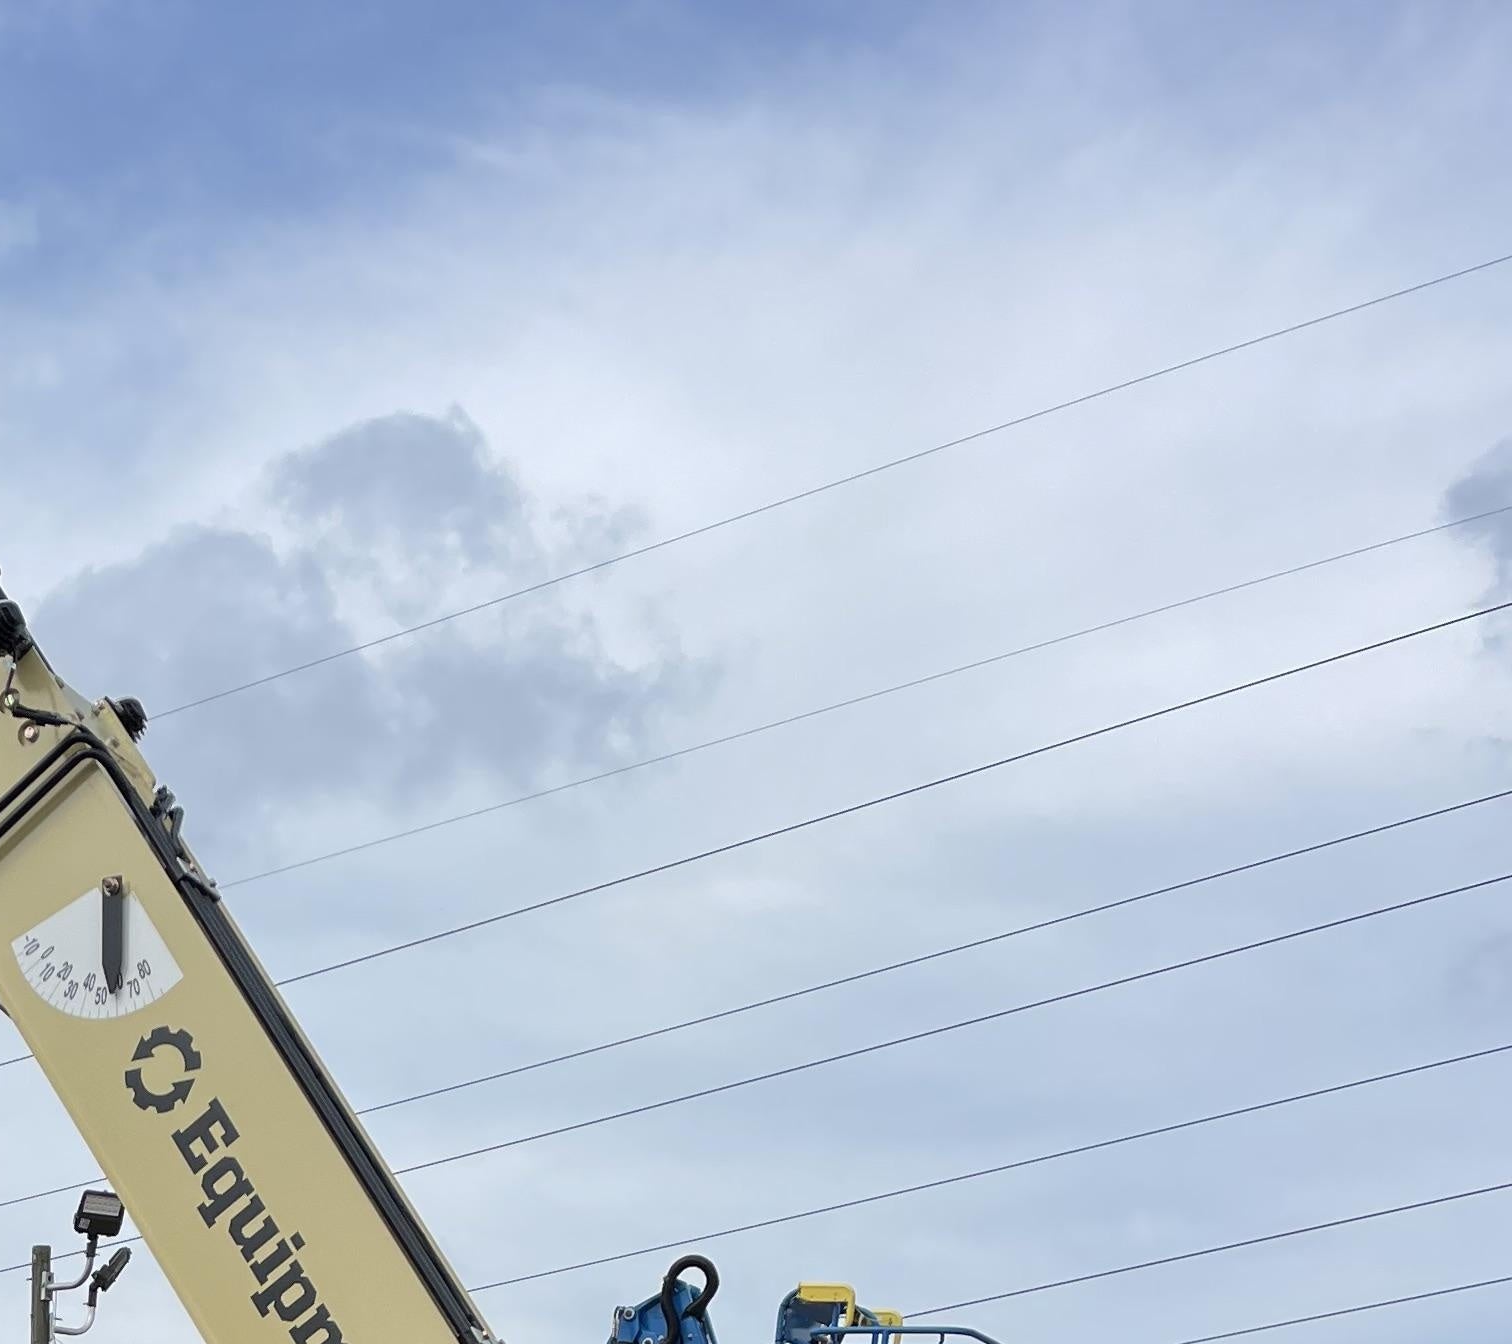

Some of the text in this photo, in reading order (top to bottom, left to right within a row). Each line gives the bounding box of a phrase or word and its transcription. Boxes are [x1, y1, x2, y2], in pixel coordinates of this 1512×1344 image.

[41, 946, 55, 960] 0
[40, 962, 55, 982] 10
[56, 961, 73, 981] 20
[137, 959, 151, 980] 80
[64, 980, 78, 1000] 30
[83, 972, 96, 992] 40
[126, 980, 141, 998] 70
[94, 986, 107, 1005] 50
